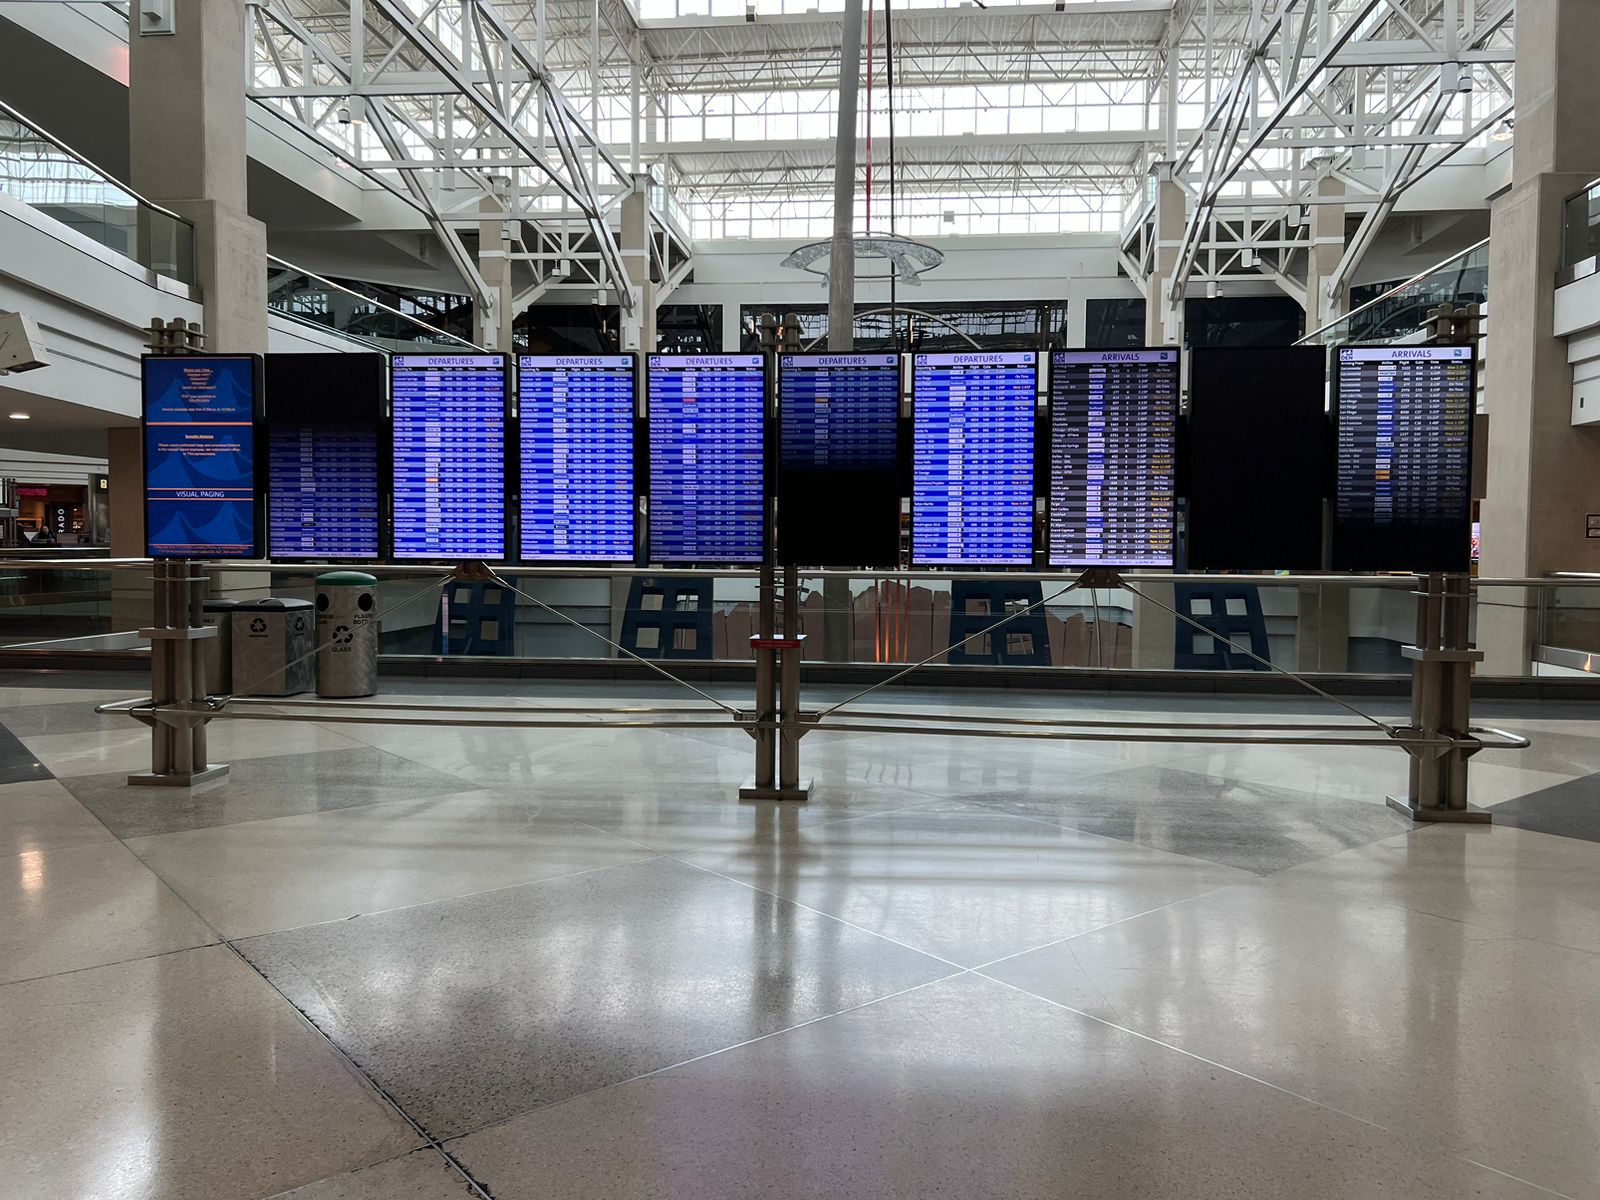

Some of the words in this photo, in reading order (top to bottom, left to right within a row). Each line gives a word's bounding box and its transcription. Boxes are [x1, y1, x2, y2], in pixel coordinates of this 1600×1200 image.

[1101, 353, 1140, 361] ARRIVALS
[1391, 350, 1432, 358] ARRIVALS
[428, 357, 474, 365] DEPARTURES
[556, 358, 603, 366] DEPARTURES
[685, 357, 733, 366] DEPARTURES
[818, 357, 867, 365] DEPARTURES
[953, 355, 1003, 364] DEPARTURES
